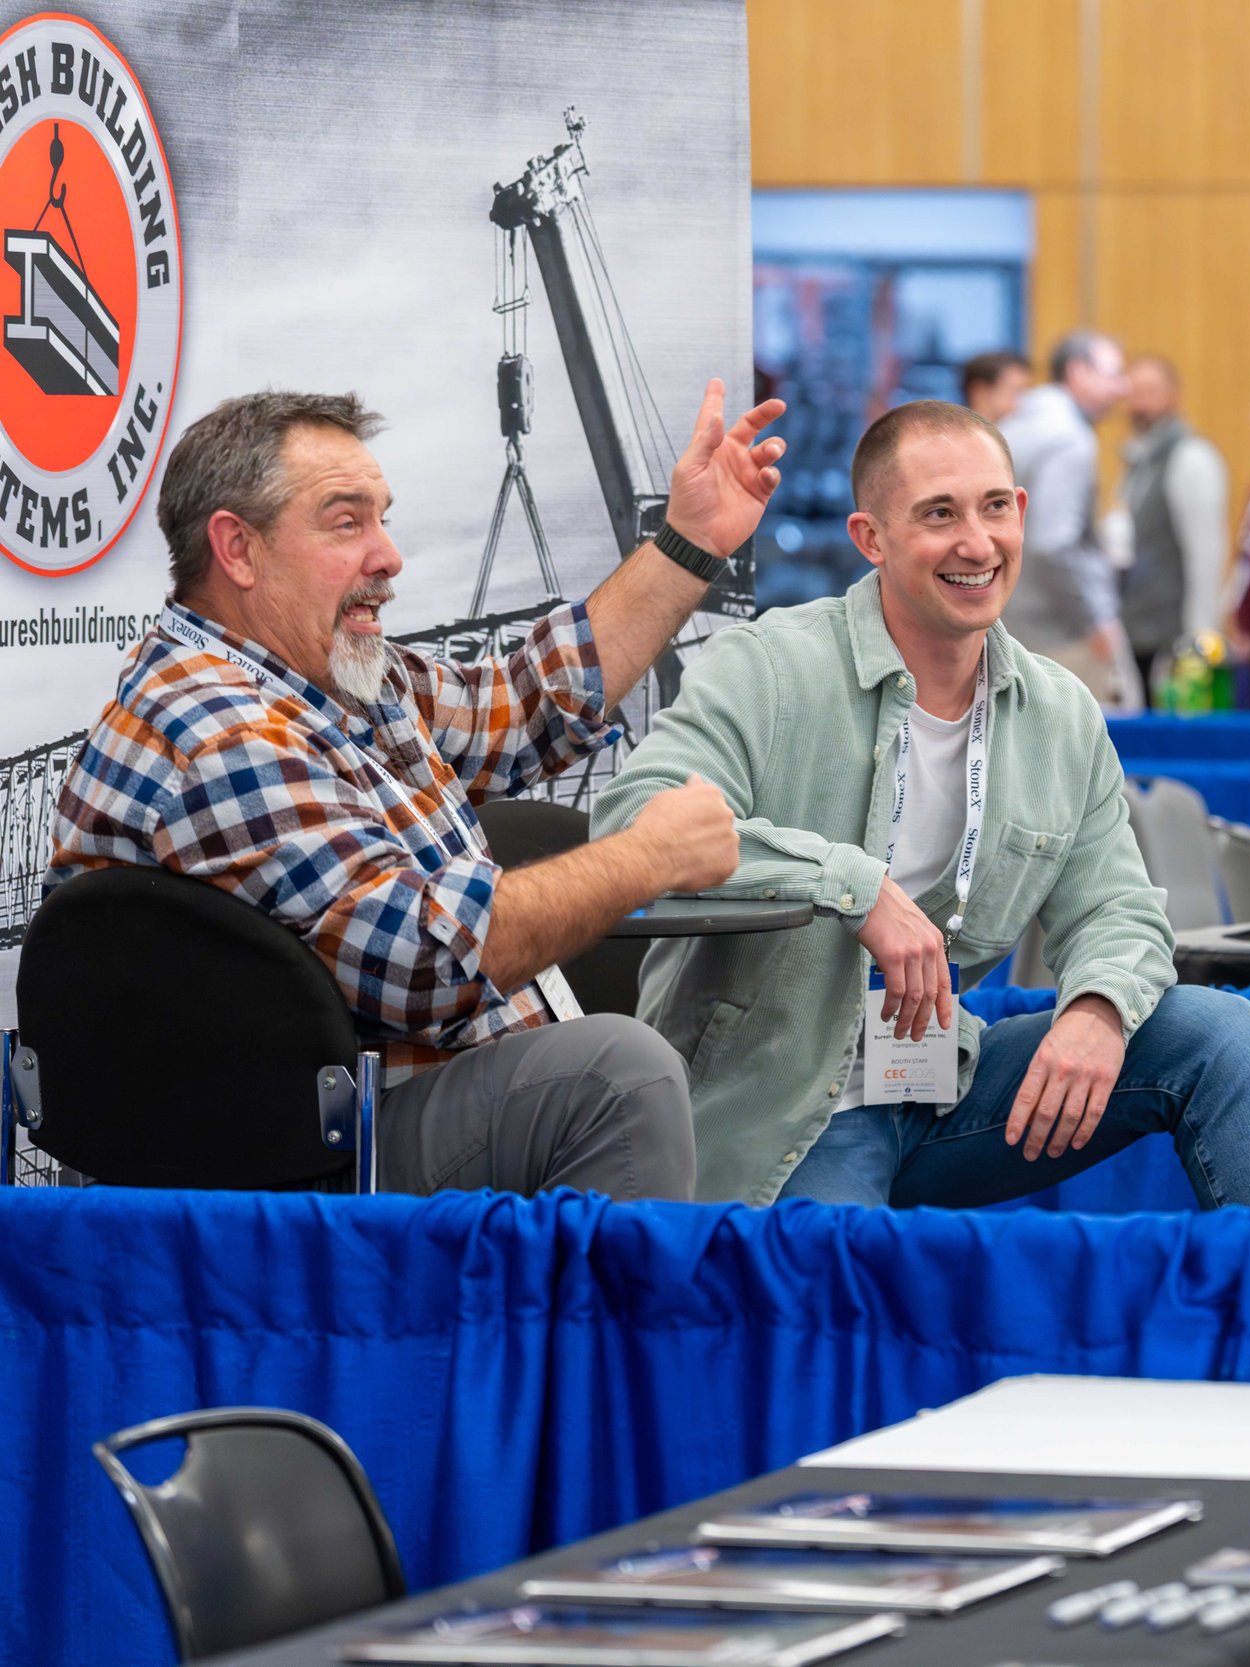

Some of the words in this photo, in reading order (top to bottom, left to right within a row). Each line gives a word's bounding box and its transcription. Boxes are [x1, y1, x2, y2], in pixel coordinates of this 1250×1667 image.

[0, 45, 41, 133] SH
[51, 42, 170, 289] BUILDING
[107, 382, 162, 504] INC.
[167, 617, 209, 650] StoneX
[971, 700, 985, 744] StoneX
[892, 770, 906, 823] StoneX
[970, 759, 983, 811] StoneX
[959, 828, 978, 880] StoneX
[884, 1069, 907, 1079] CEC
